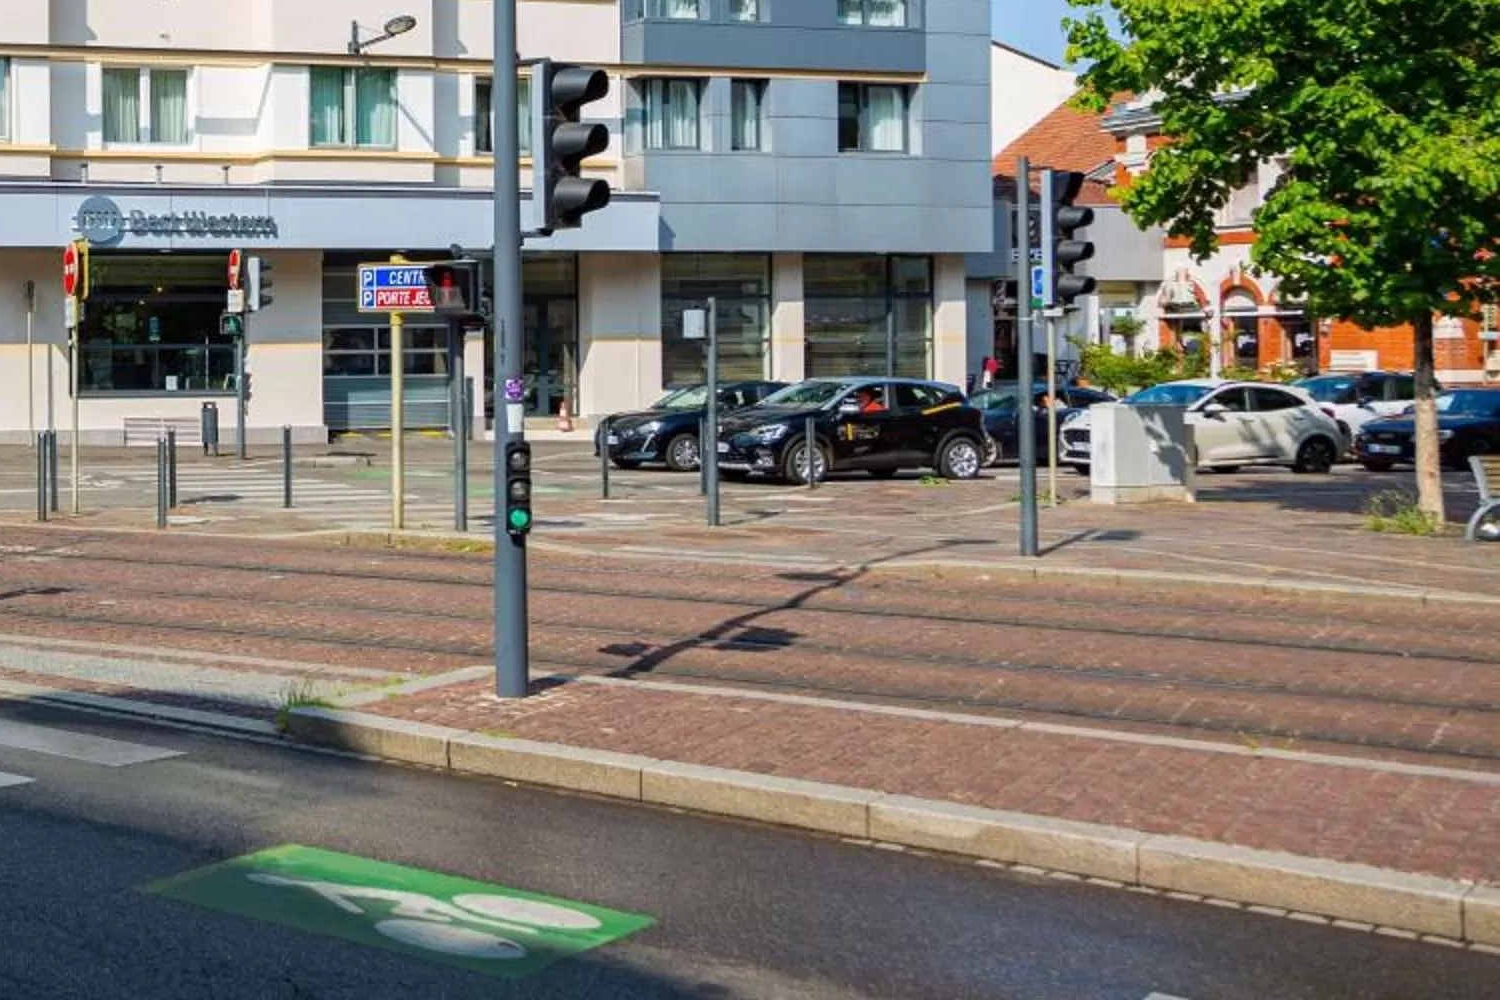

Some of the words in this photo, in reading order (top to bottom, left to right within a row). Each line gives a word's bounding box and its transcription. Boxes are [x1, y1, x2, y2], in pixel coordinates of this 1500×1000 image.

[129, 209, 181, 237] Best
[183, 210, 278, 239] Western
[363, 271, 373, 287] P
[389, 270, 427, 285] CENTR
[363, 291, 373, 306] P
[377, 290, 411, 305] PORTE
[412, 290, 431, 305] JEU
